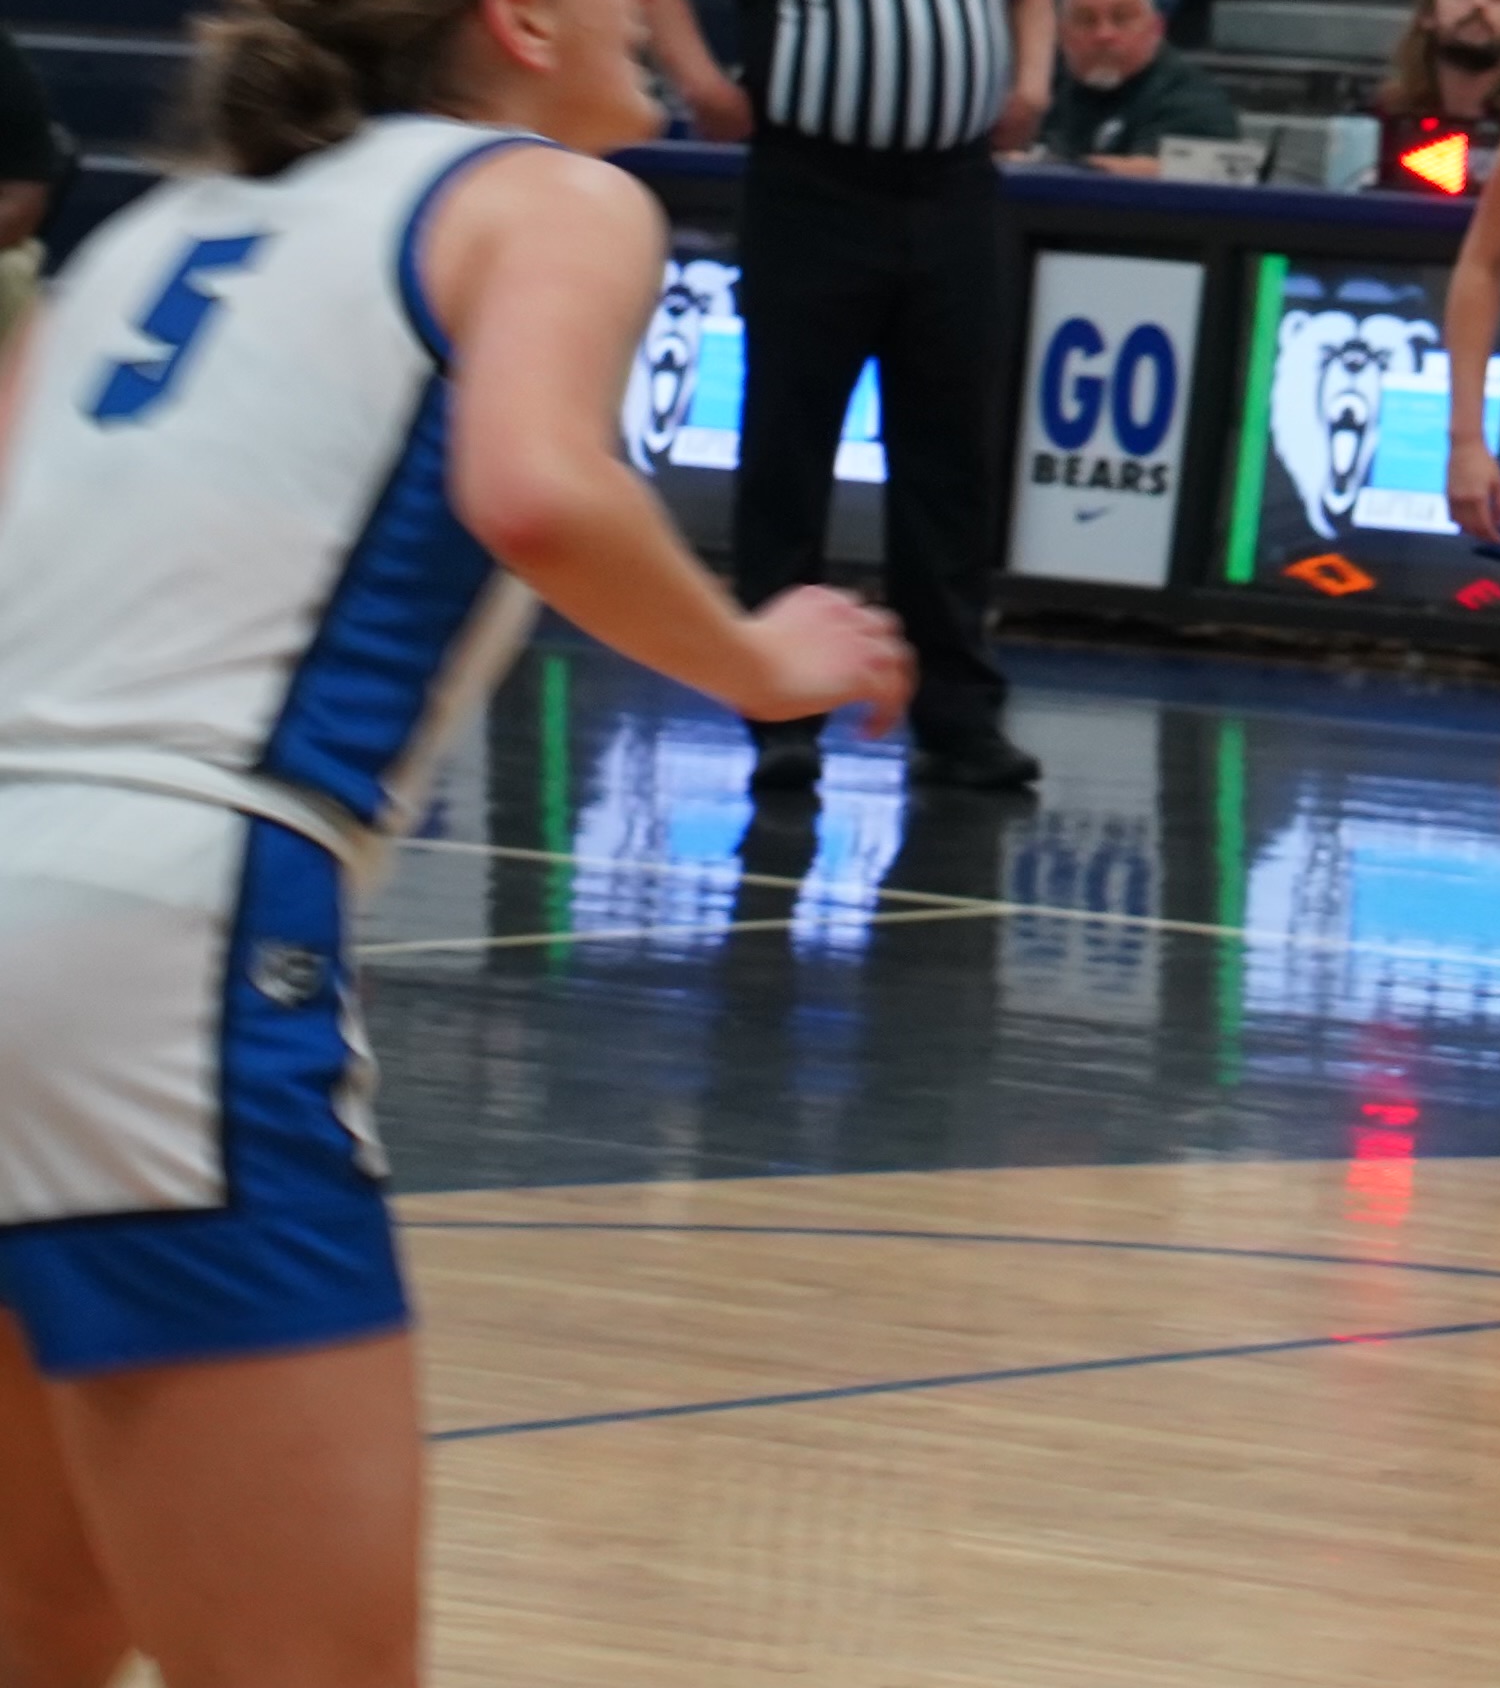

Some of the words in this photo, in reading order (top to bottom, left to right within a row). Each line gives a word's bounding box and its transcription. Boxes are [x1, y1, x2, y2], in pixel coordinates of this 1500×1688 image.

[80, 230, 275, 432] 5
[1040, 317, 1176, 457] GO
[1033, 452, 1168, 495] BEARS
